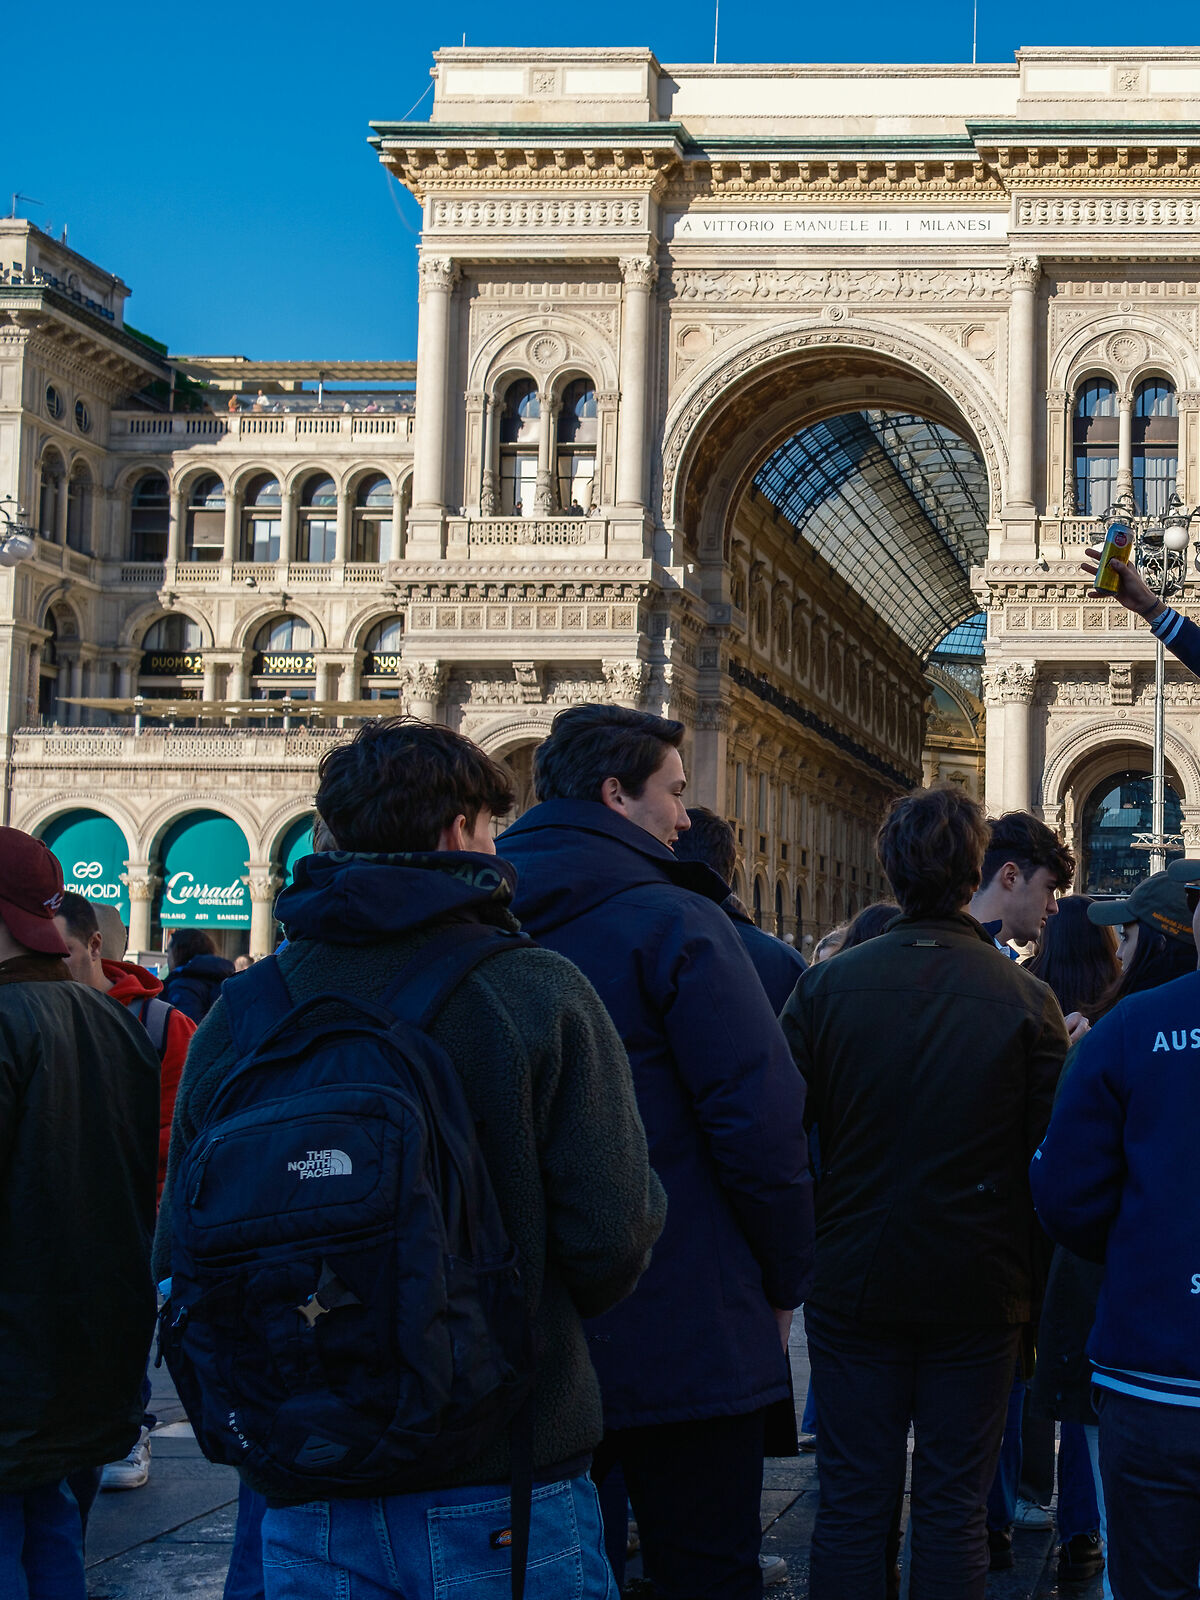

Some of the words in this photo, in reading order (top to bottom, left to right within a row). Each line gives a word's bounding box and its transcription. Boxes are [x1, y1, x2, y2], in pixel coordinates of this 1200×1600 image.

[682, 220, 693, 232] A
[703, 219, 775, 232] VITTORIO
[783, 219, 869, 232] EMANUELE
[919, 219, 992, 232] MILANESI
[151, 656, 192, 669] DUOMO
[166, 871, 245, 905] Currado
[160, 912, 186, 920] MILANO
[306, 1149, 331, 1160] THE
[287, 1159, 331, 1171] NORTH
[300, 1167, 331, 1180] FACE
